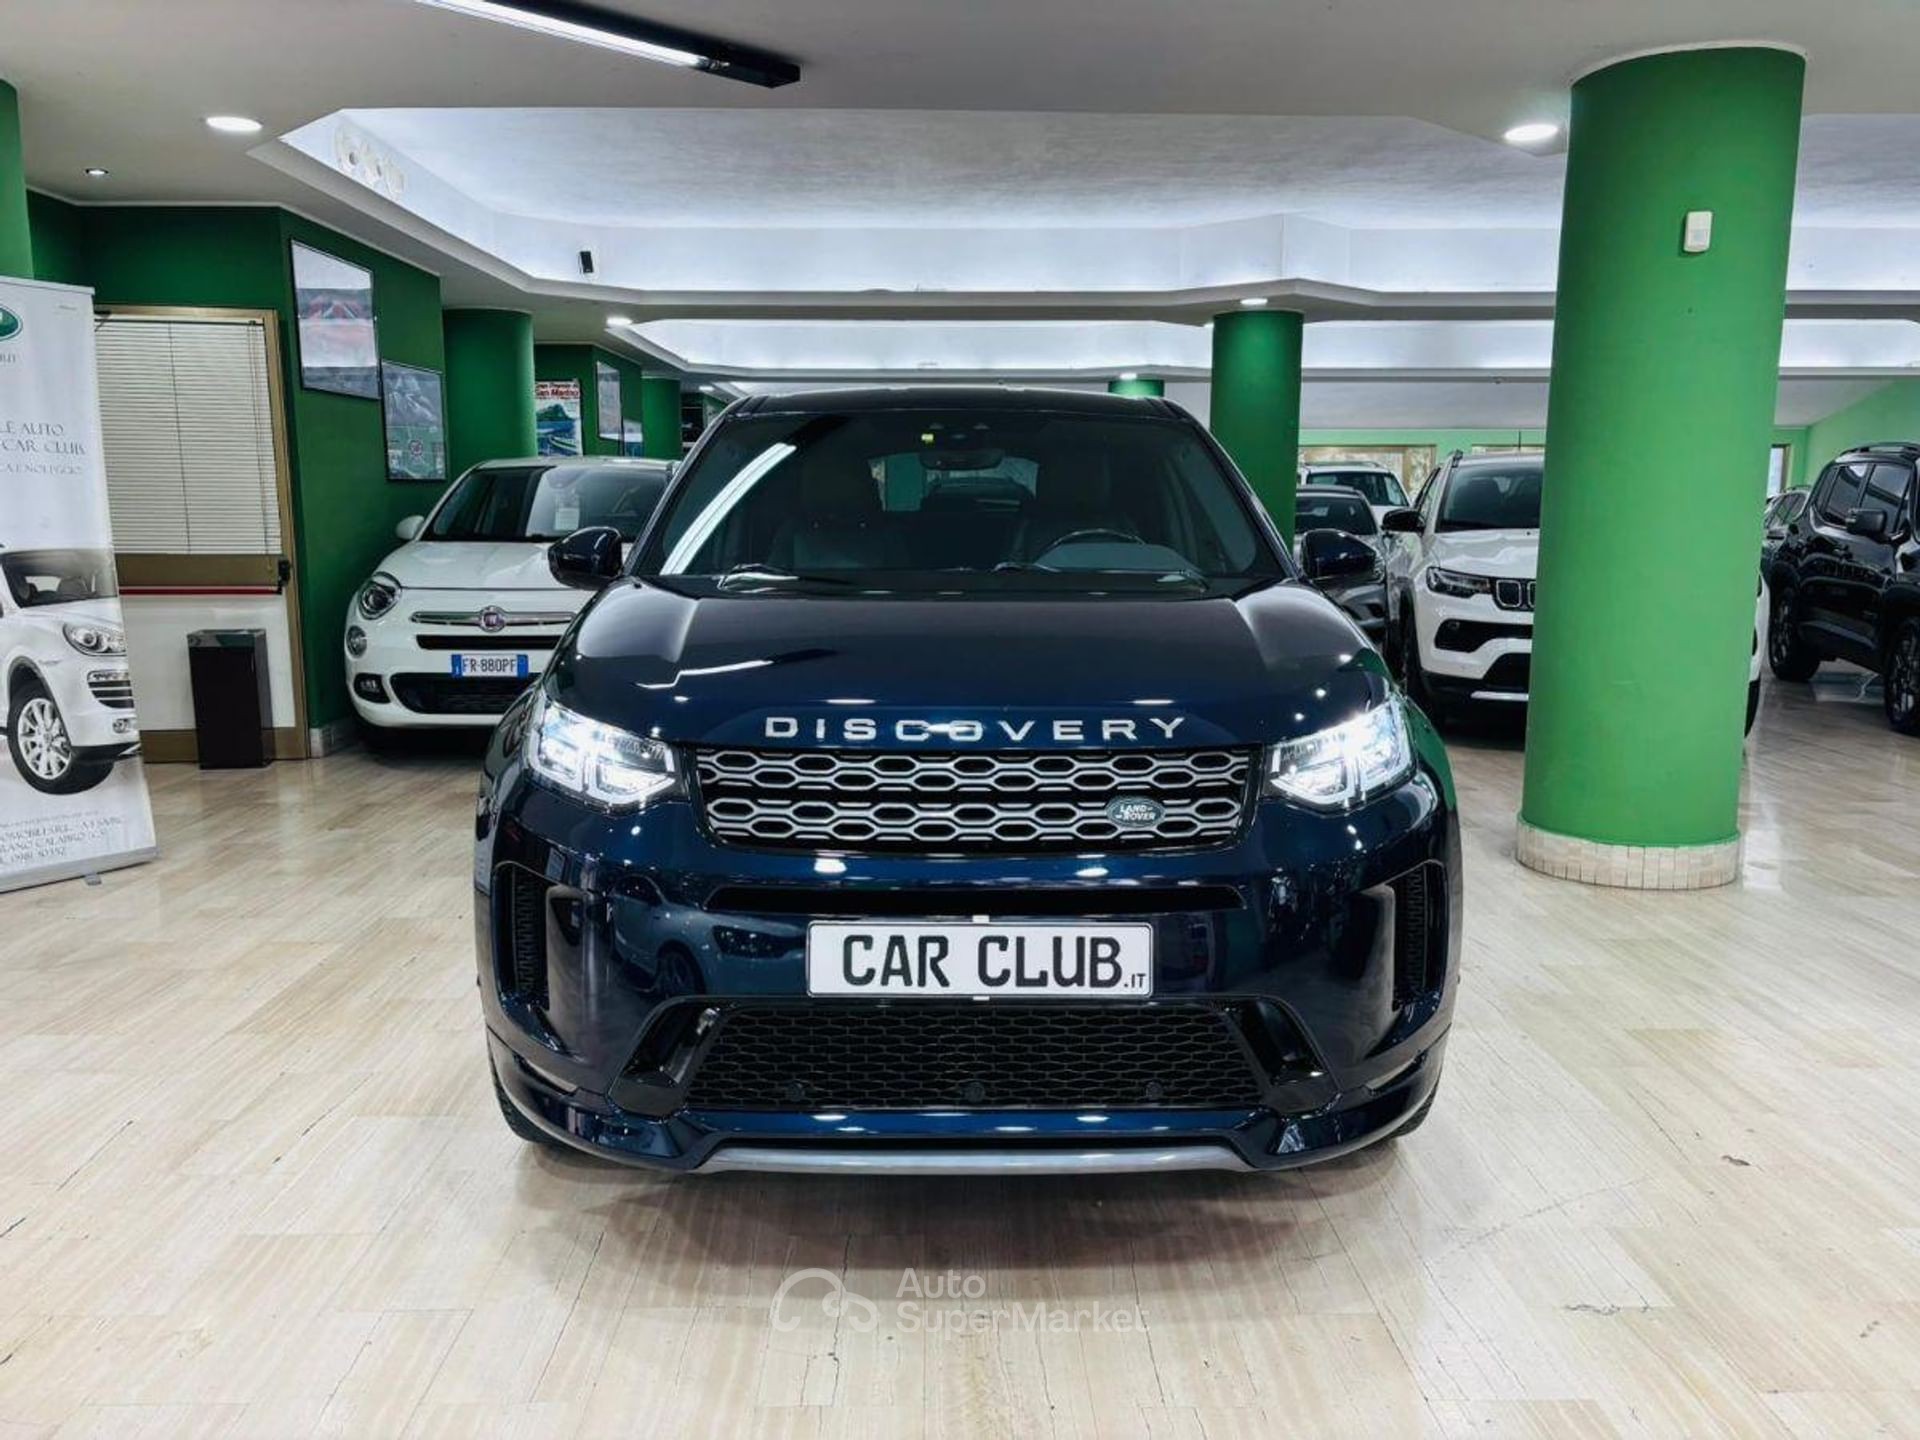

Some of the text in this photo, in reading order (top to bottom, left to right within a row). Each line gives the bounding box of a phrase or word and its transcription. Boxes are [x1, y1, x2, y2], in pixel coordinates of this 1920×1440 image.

[21, 423, 64, 437] AUTO
[2, 439, 86, 456] CAR CLUB
[764, 716, 1185, 742] DISCOVERY
[843, 935, 950, 988] CAR
